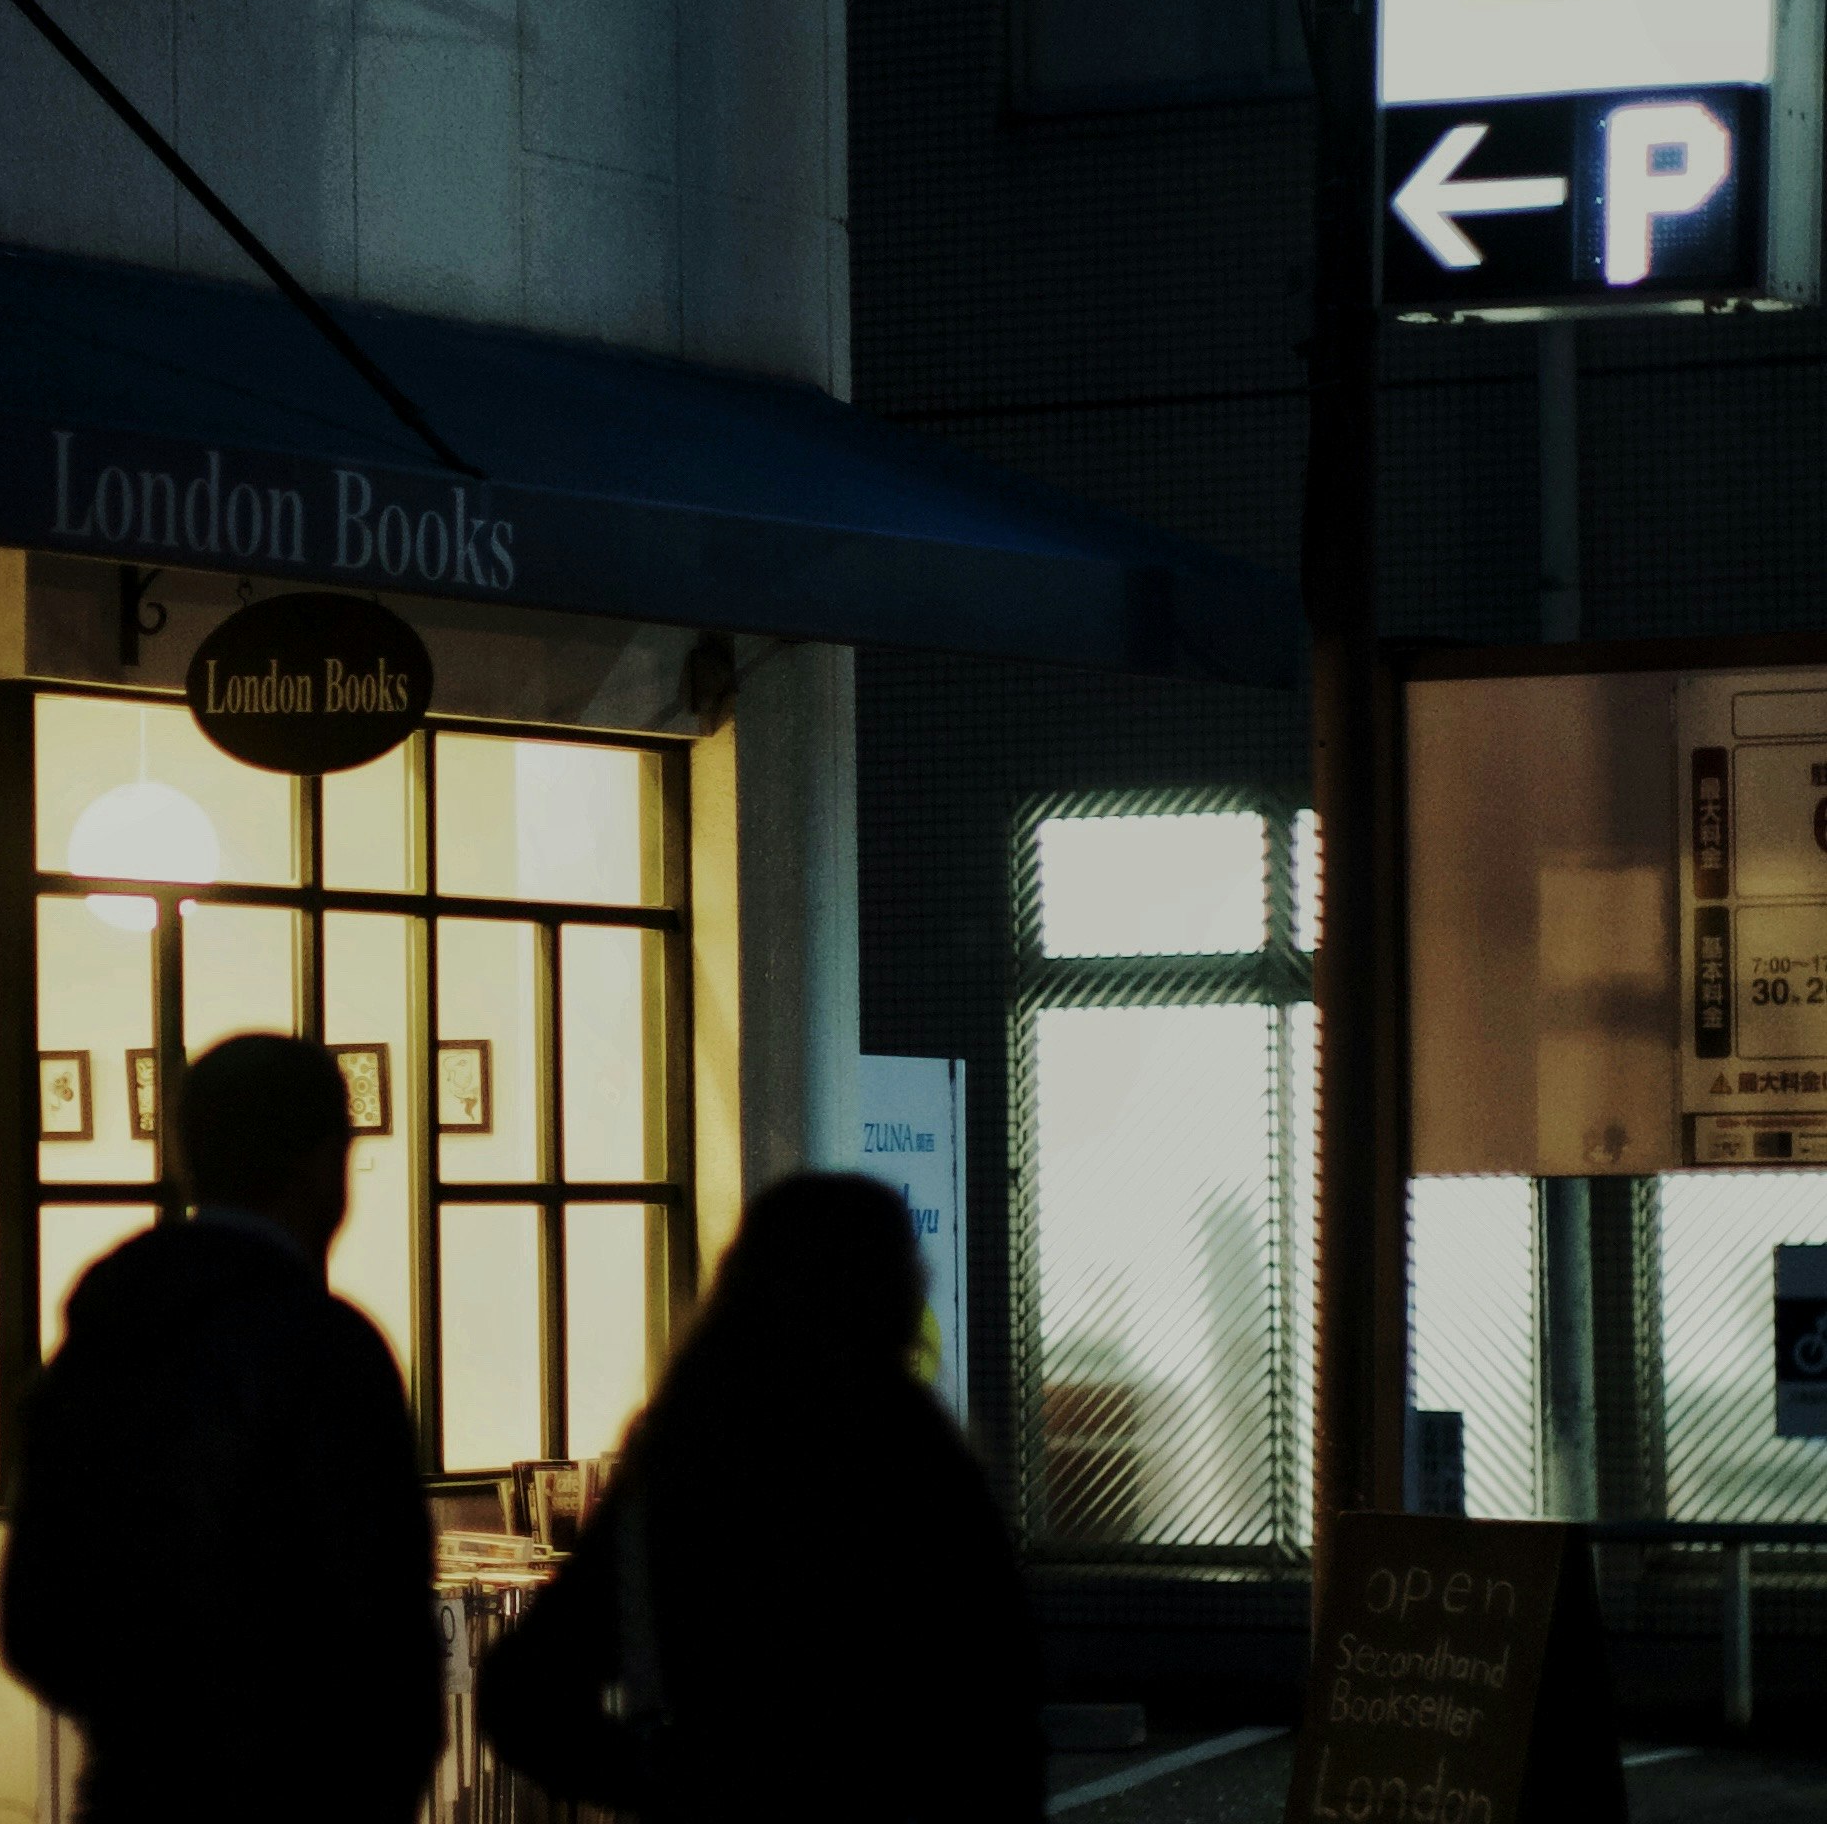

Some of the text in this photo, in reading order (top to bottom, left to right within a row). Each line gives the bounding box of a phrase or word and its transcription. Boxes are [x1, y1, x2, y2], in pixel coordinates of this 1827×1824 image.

[1604, 101, 1733, 288] P
[51, 429, 515, 591] London Books
[204, 657, 409, 714] London Books
[1739, 1070, 1827, 1094] 最大料金
[1334, 1631, 1511, 1689] Secondhand
[1329, 1676, 1485, 1738] Bookseller
